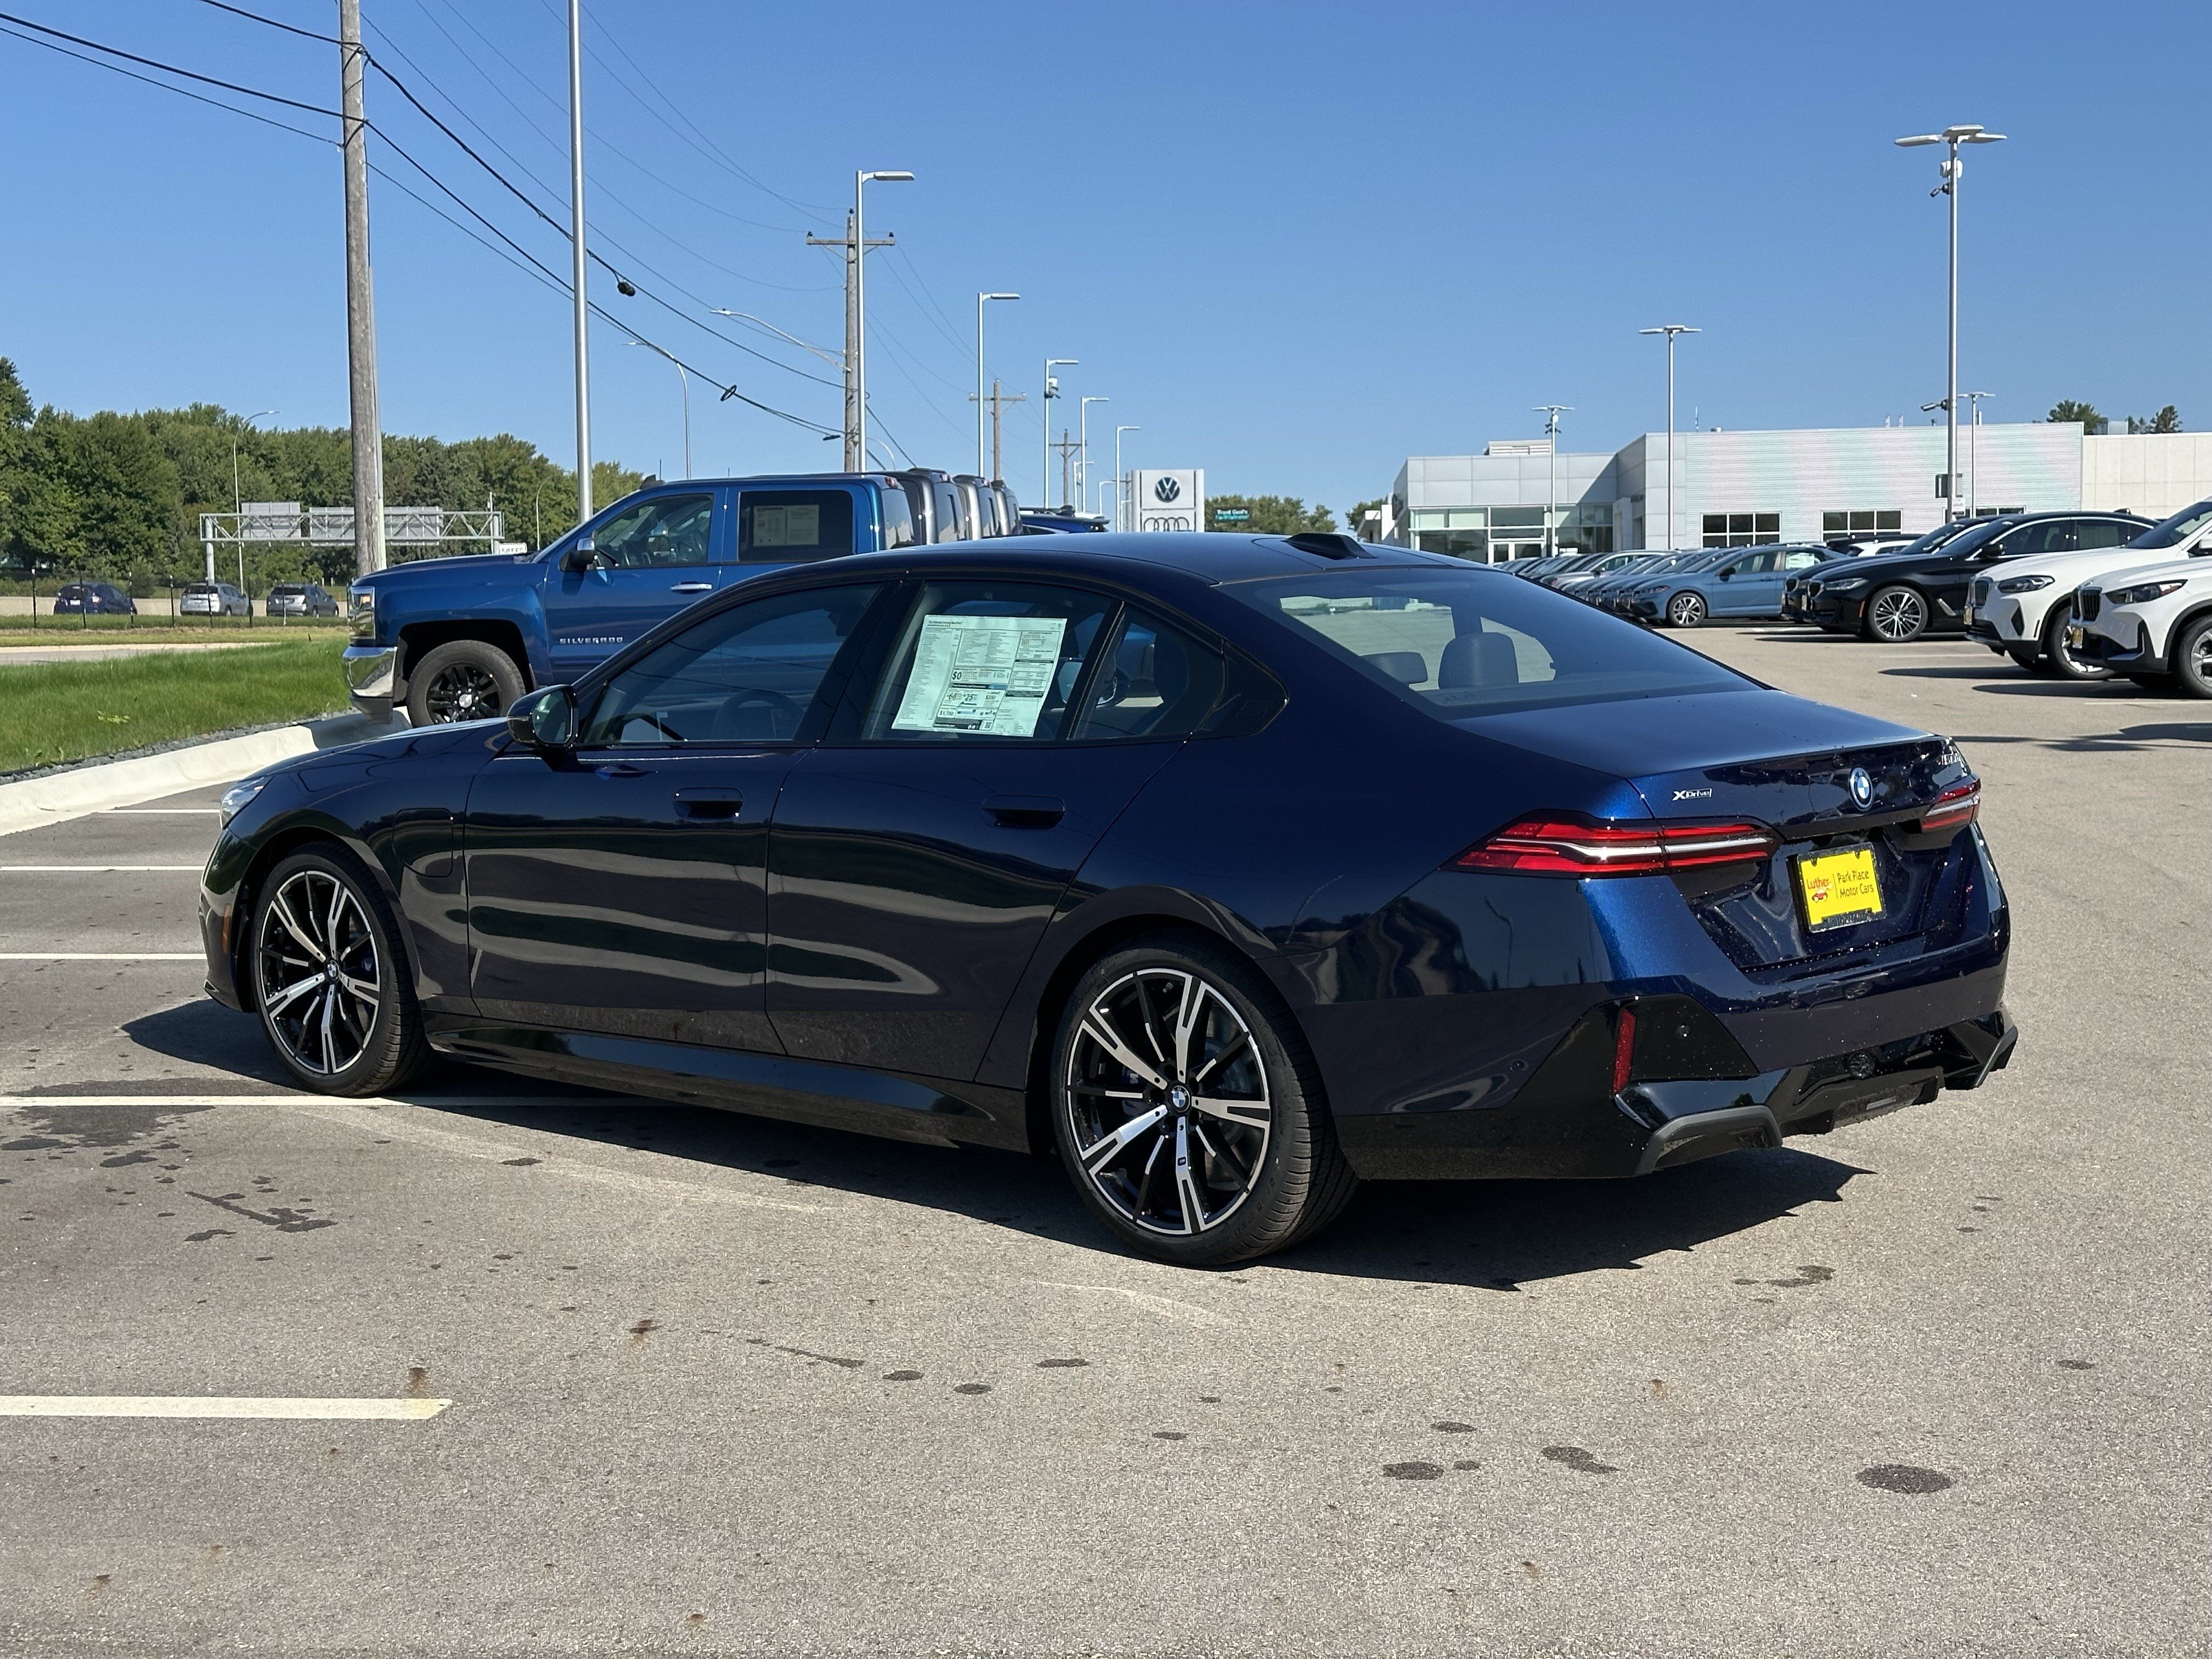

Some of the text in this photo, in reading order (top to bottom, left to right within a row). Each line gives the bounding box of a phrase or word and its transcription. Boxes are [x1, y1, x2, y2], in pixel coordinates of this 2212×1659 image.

[952, 671, 962, 680] $0
[1837, 870, 1870, 883] Park Place
[1807, 877, 1830, 889] Luther
[1840, 883, 1874, 898] Motor Cars
